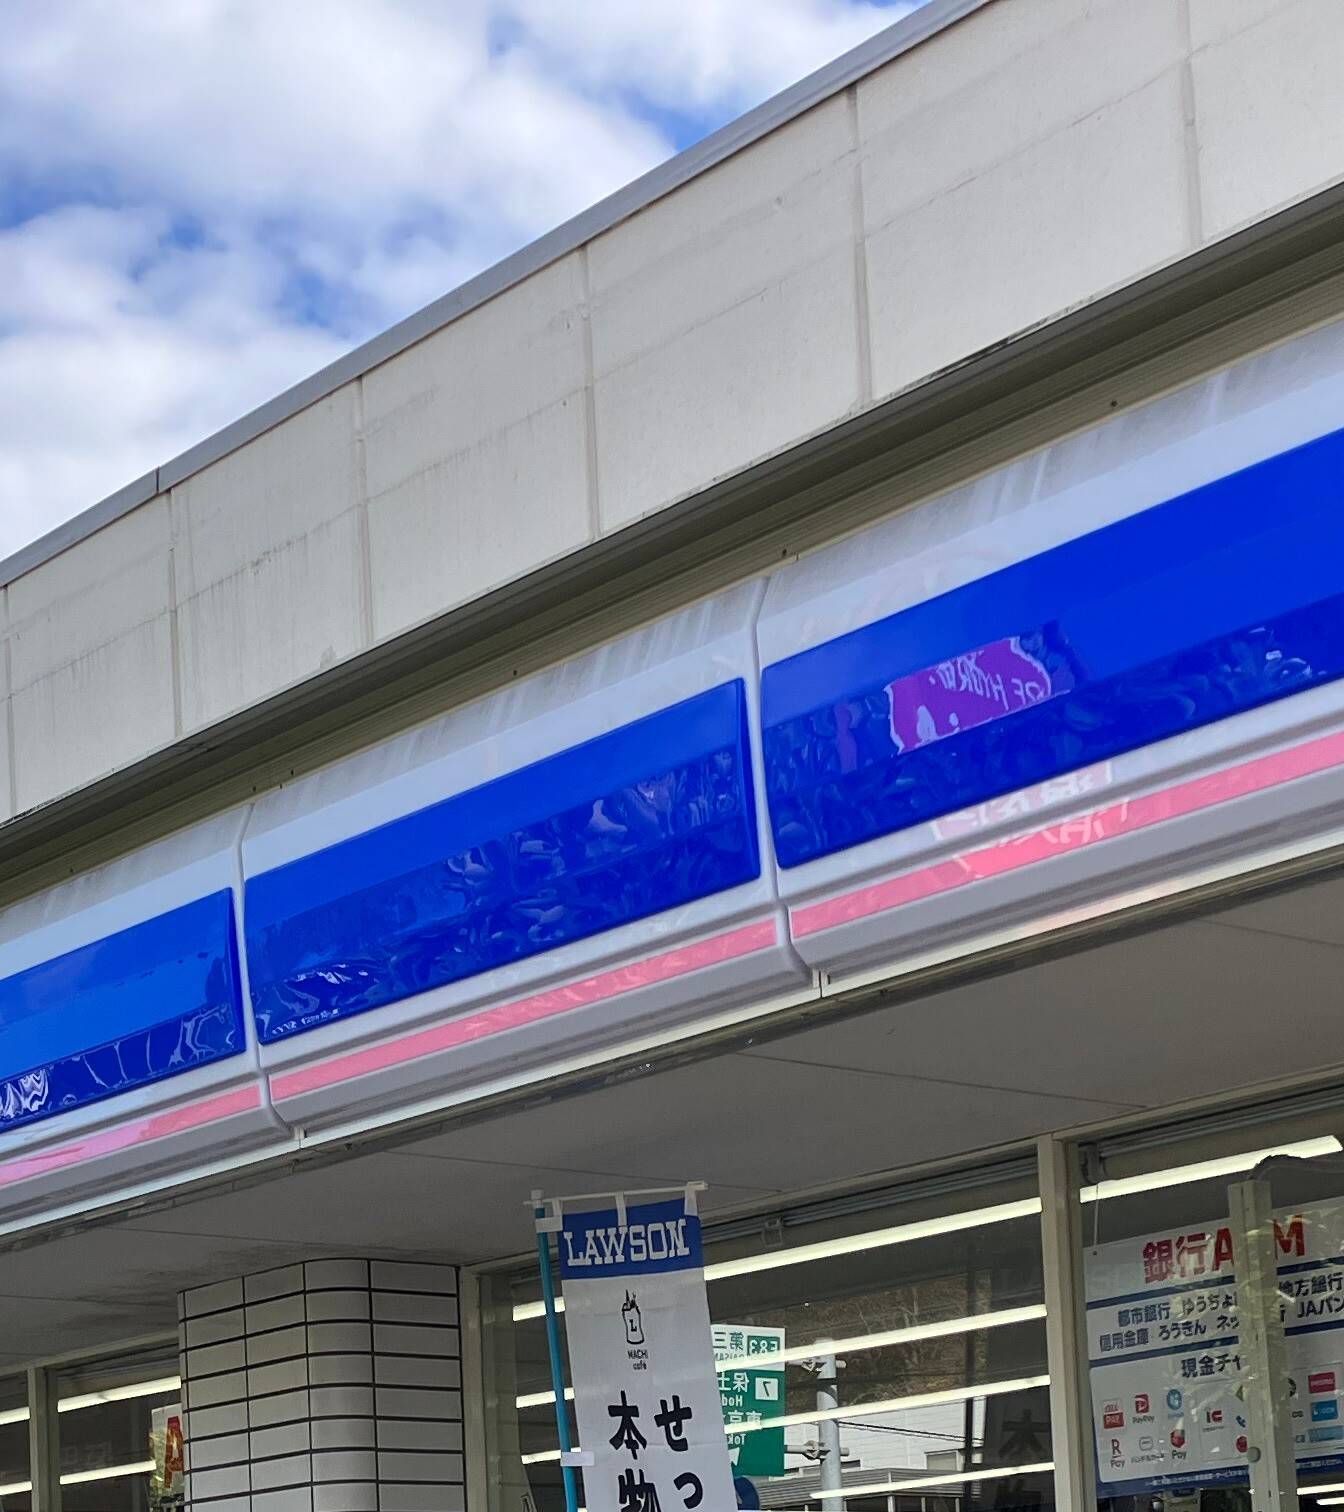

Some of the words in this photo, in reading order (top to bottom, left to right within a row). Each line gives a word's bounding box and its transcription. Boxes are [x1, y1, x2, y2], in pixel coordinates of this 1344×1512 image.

[563, 1208, 690, 1266] LAWSON
[1142, 1215, 1305, 1284] 銀行AM
[1158, 1319, 1207, 1341] ろうきん
